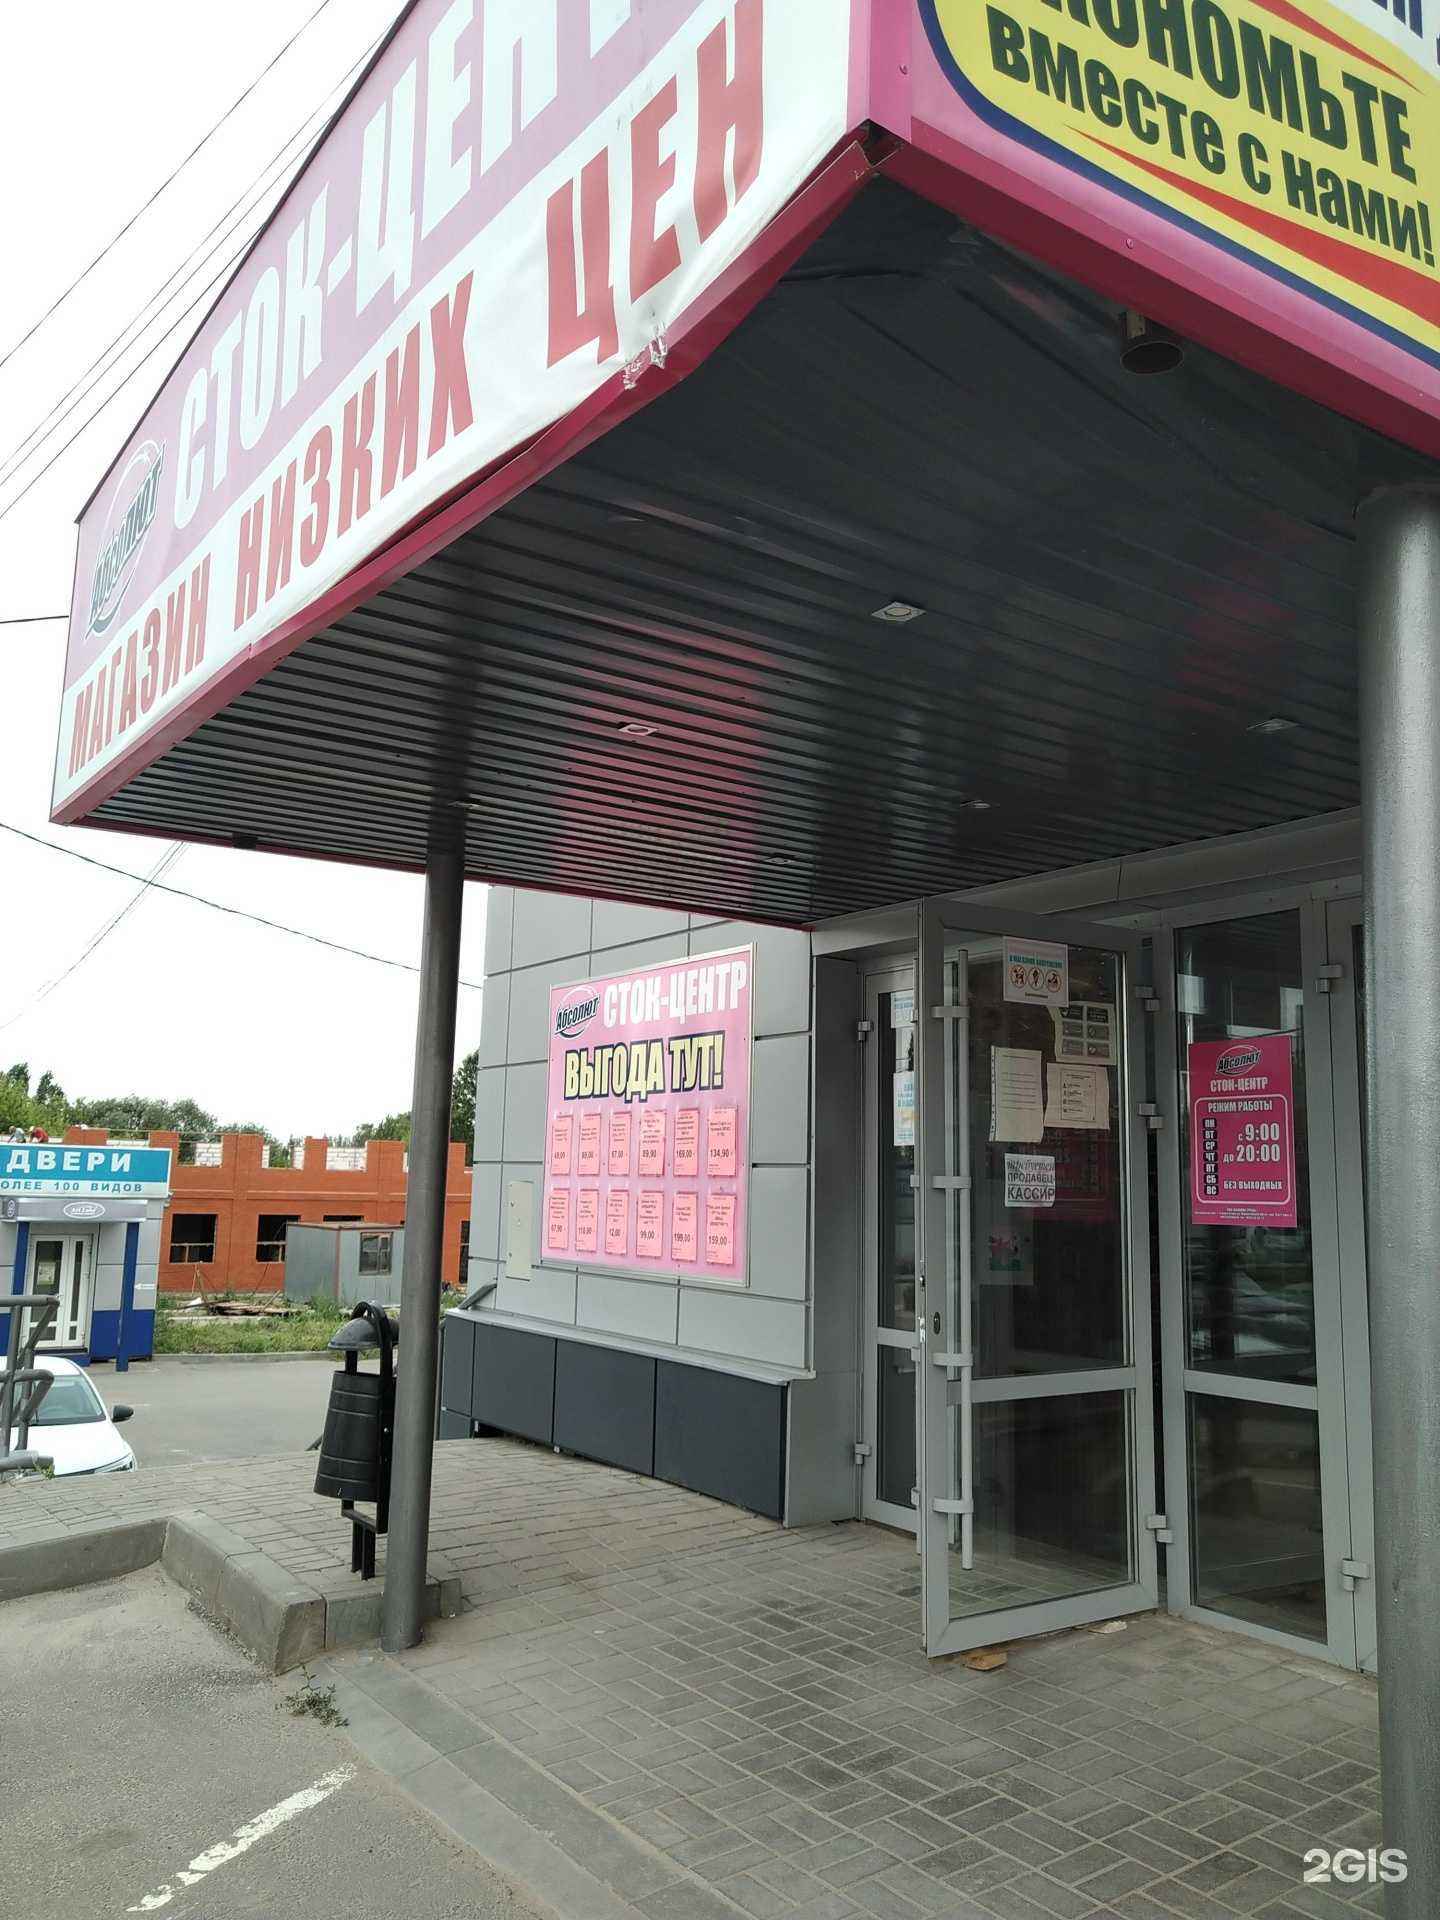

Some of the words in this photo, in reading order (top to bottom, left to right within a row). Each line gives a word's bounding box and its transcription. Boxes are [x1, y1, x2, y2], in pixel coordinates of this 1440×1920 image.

[1238, 131, 1272, 197] с
[1281, 151, 1436, 269] нами!
[172, 0, 630, 530] СТОК-ЦЕН
[68, 551, 212, 781] МАГАЗИН
[233, 269, 476, 632] НИЗКИХ
[546, 0, 764, 368] ЦЕН
[603, 960, 747, 1029] СТОК-ЦЕНТР
[564, 1039, 666, 1104] ВЫГОДА
[668, 1031, 726, 1093] ТУТ!
[1210, 1077, 1268, 1093] СТОК-ЦЕНТР
[1207, 1101, 1237, 1112] РЕЖИМ
[1238, 1100, 1273, 1111] РАБОТЫ
[1204, 1119, 1215, 1128] ПН
[1205, 1130, 1215, 1139] ВТ
[1245, 1123, 1280, 1141] 9:00
[1205, 1142, 1215, 1151] СР
[1205, 1152, 1215, 1160] ЧТ
[1236, 1144, 1281, 1162] 20:00
[6, 1149, 132, 1174] ДВЕРИ
[1206, 1163, 1216, 1172] ПТ
[1206, 1175, 1217, 1184] СБ
[54, 1182, 80, 1191] 100
[90, 1183, 143, 1194] ВИДОВ
[1206, 1186, 1217, 1195] ВС
[1224, 1181, 1237, 1190] БЕЗ
[1238, 1181, 1283, 1191] ВЫХОДНЫХ
[1007, 1187, 1055, 1200] КАССИР
